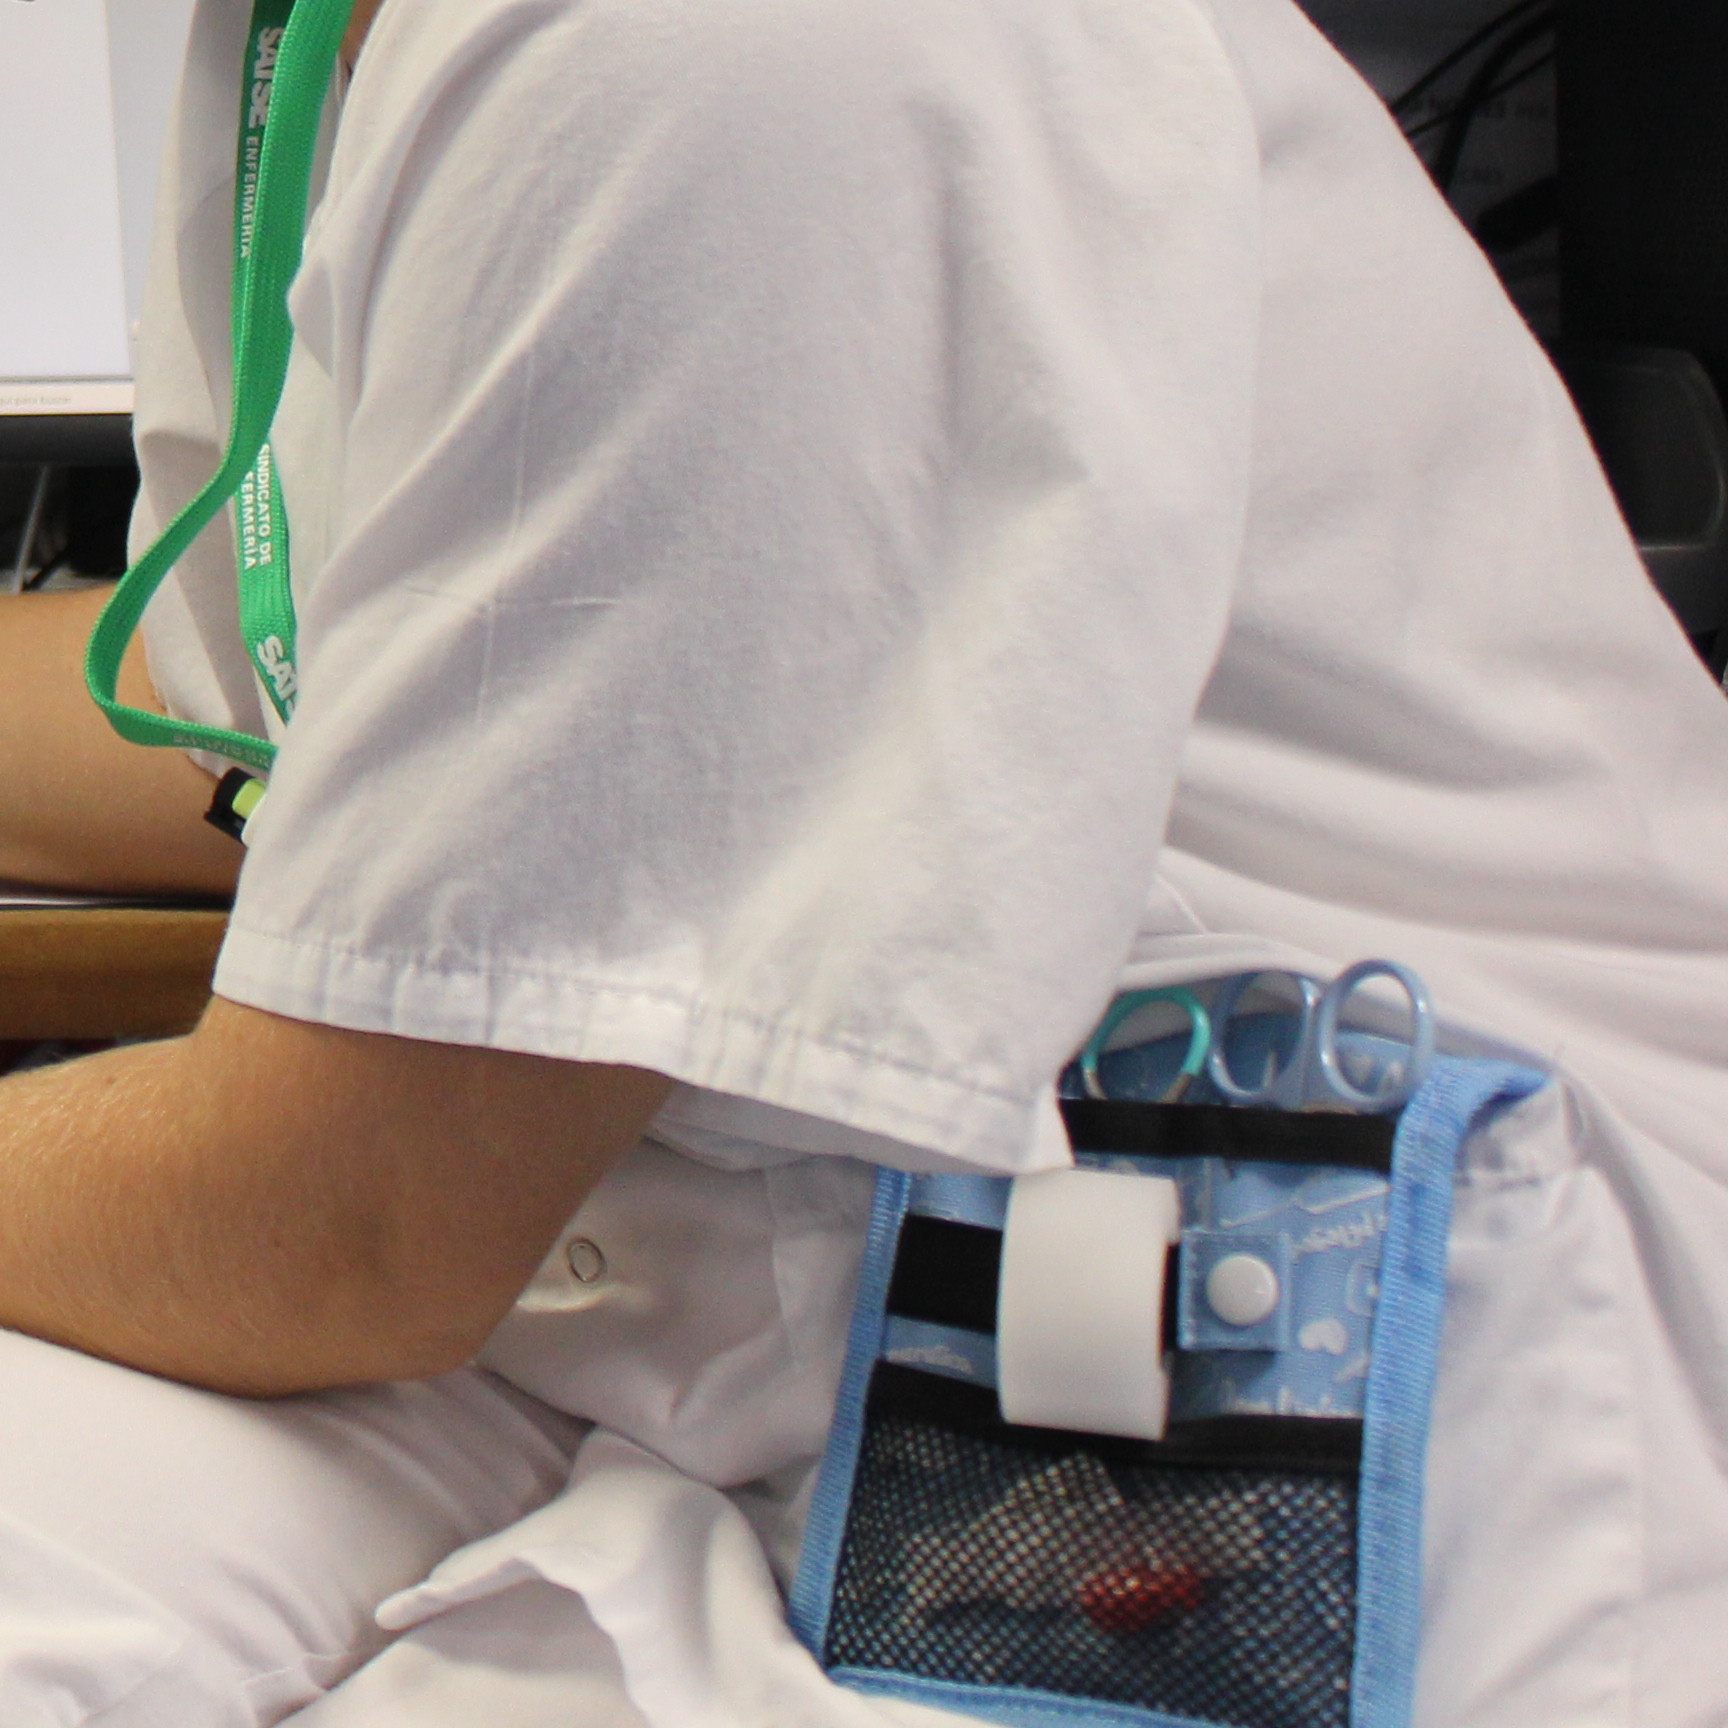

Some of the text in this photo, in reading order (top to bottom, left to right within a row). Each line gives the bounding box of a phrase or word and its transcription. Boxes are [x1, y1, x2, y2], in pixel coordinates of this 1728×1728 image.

[241, 469, 258, 570] FERMERÍA
[256, 443, 273, 566] SINDICATO DE
